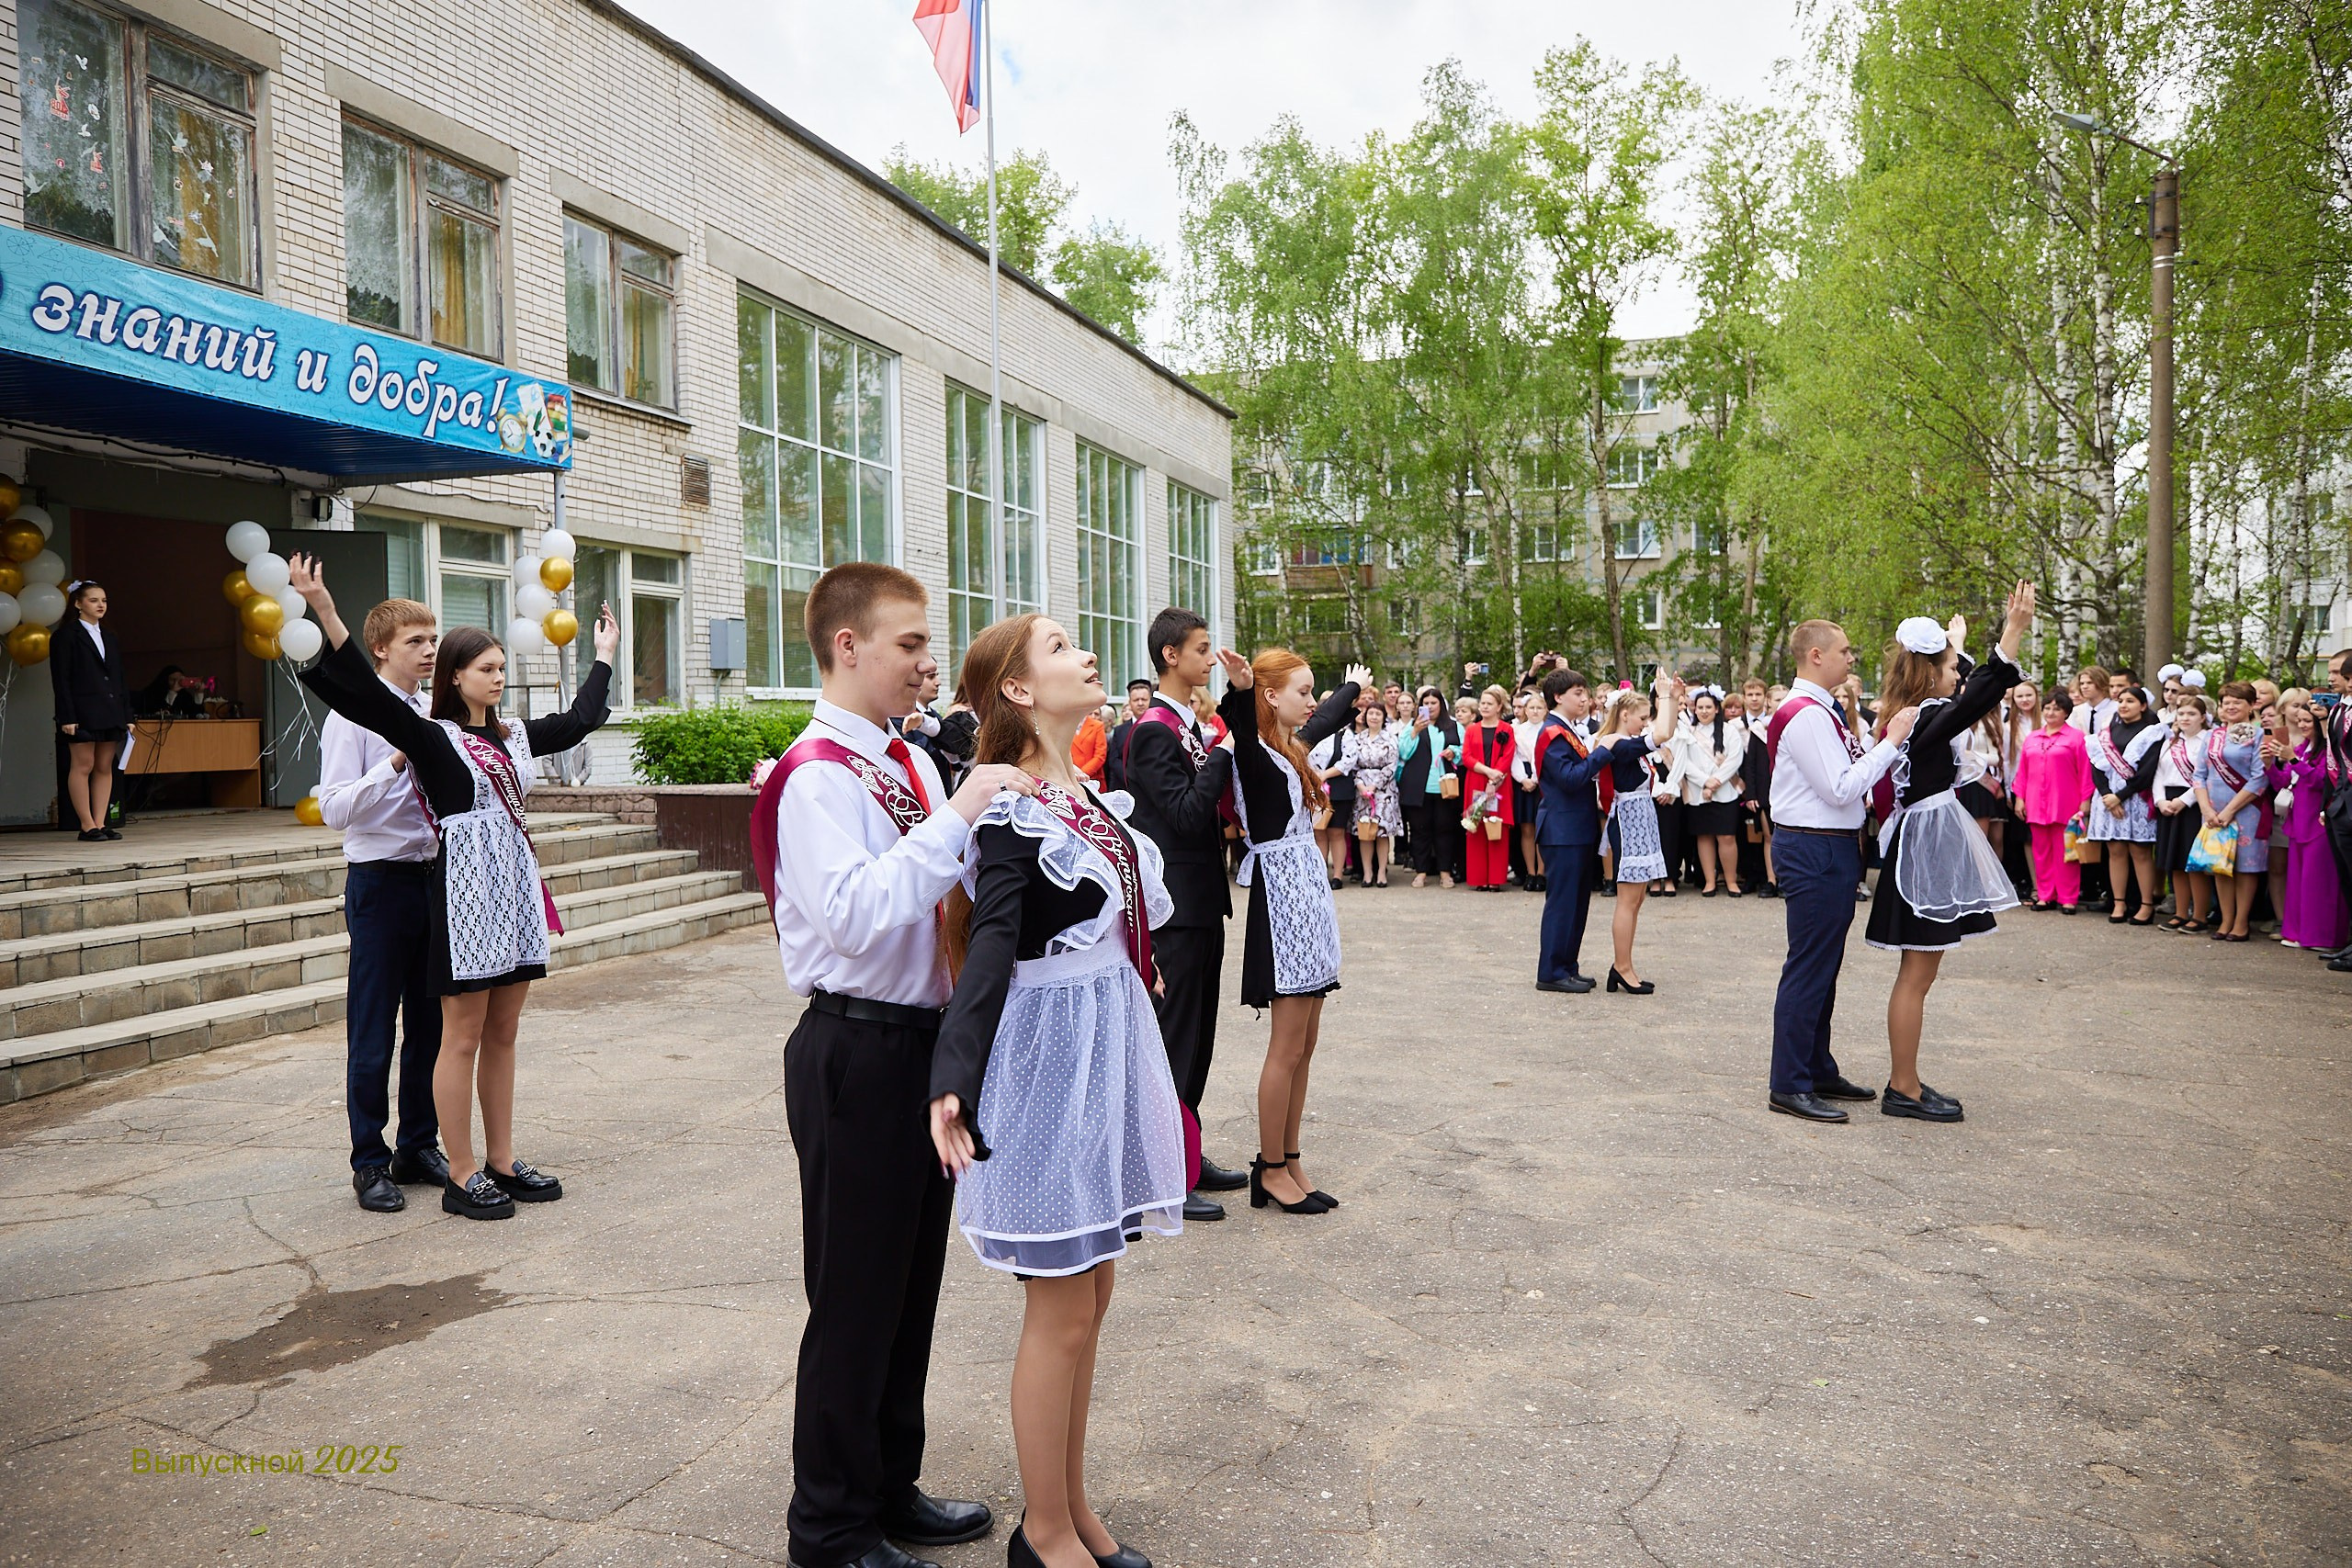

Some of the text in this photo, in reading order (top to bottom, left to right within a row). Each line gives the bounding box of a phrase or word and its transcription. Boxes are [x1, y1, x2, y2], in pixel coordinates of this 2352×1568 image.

[31, 284, 510, 438] знаний и добра!
[469, 742, 522, 811] Выпускница
